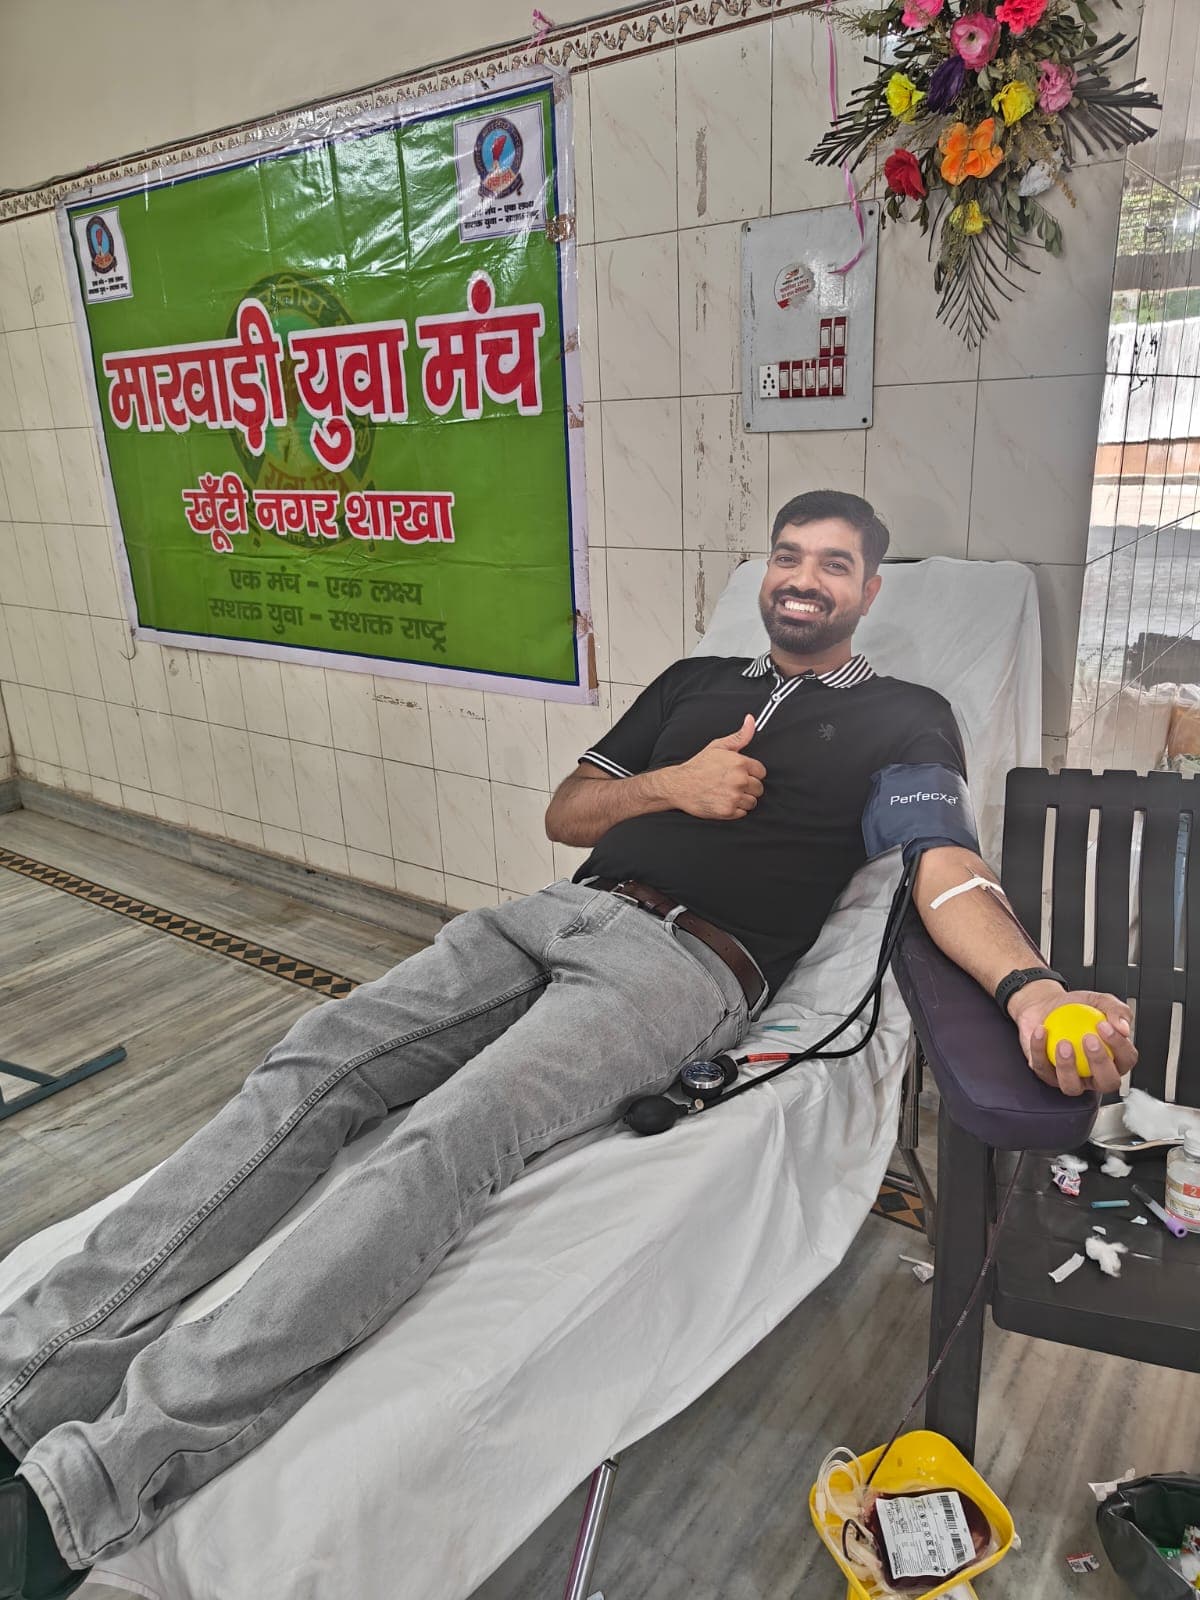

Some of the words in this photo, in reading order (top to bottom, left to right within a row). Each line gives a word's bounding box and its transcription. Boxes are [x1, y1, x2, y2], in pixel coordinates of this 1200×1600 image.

[104, 301, 286, 453] मारवाड़ी
[290, 322, 407, 469] युवा
[417, 273, 543, 418] मंच
[183, 473, 247, 552] खूँटी
[253, 491, 339, 538] नगर
[345, 492, 454, 543] शाखा
[229, 569, 262, 590] एक
[266, 565, 301, 594] मंच
[324, 576, 362, 600] एक
[369, 579, 423, 605] लक्ष्य
[208, 599, 262, 622] सशक्त
[266, 602, 303, 635] युवा
[328, 608, 393, 636] सशक्त
[890, 791, 956, 807] Perfecxa
